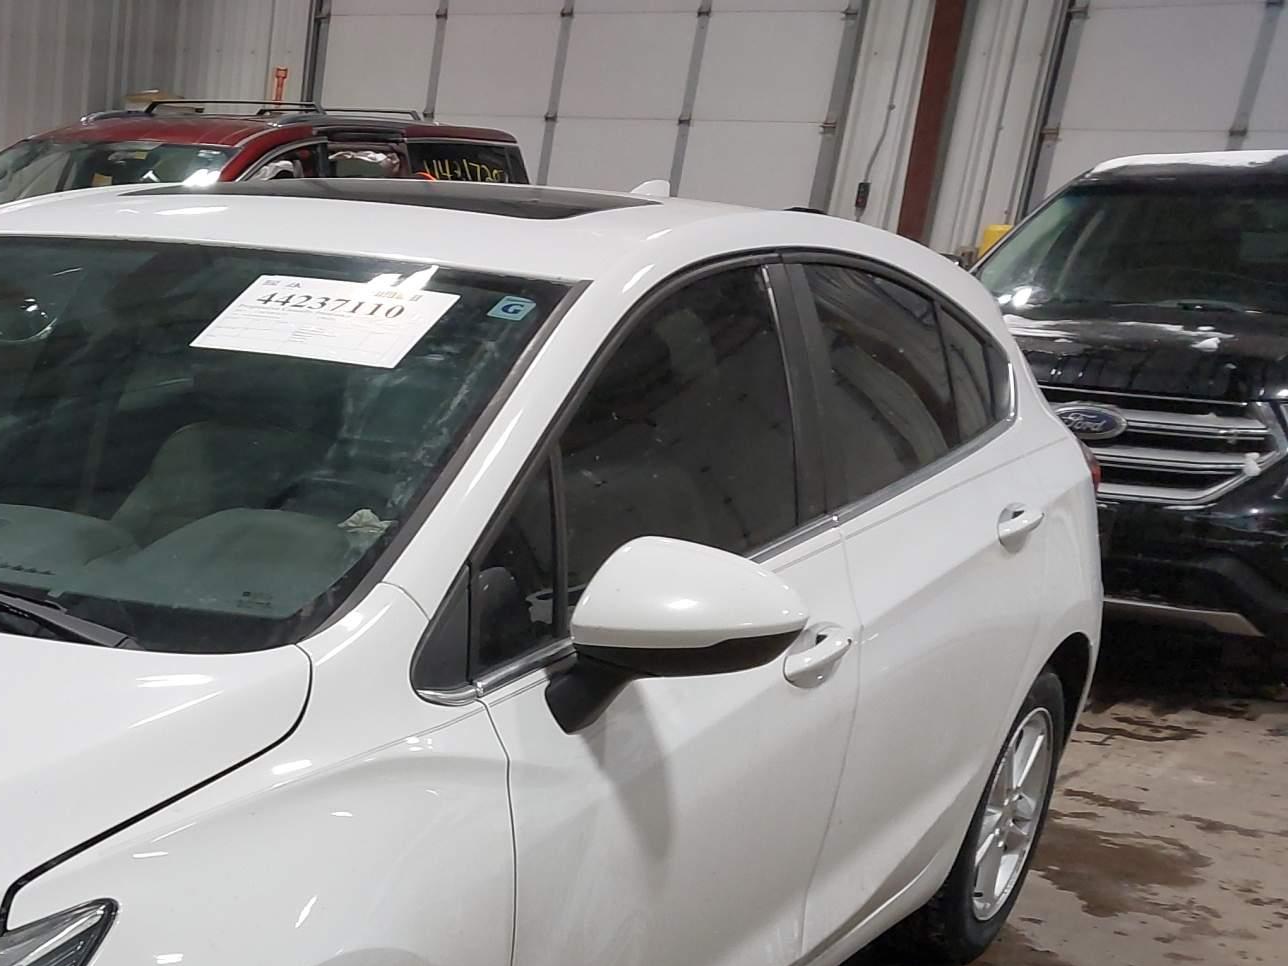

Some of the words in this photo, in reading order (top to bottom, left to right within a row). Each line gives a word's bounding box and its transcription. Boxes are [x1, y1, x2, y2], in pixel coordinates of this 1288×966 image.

[255, 292, 405, 319] 44237110
[502, 303, 525, 315] G
[1061, 412, 1107, 432] Ford
